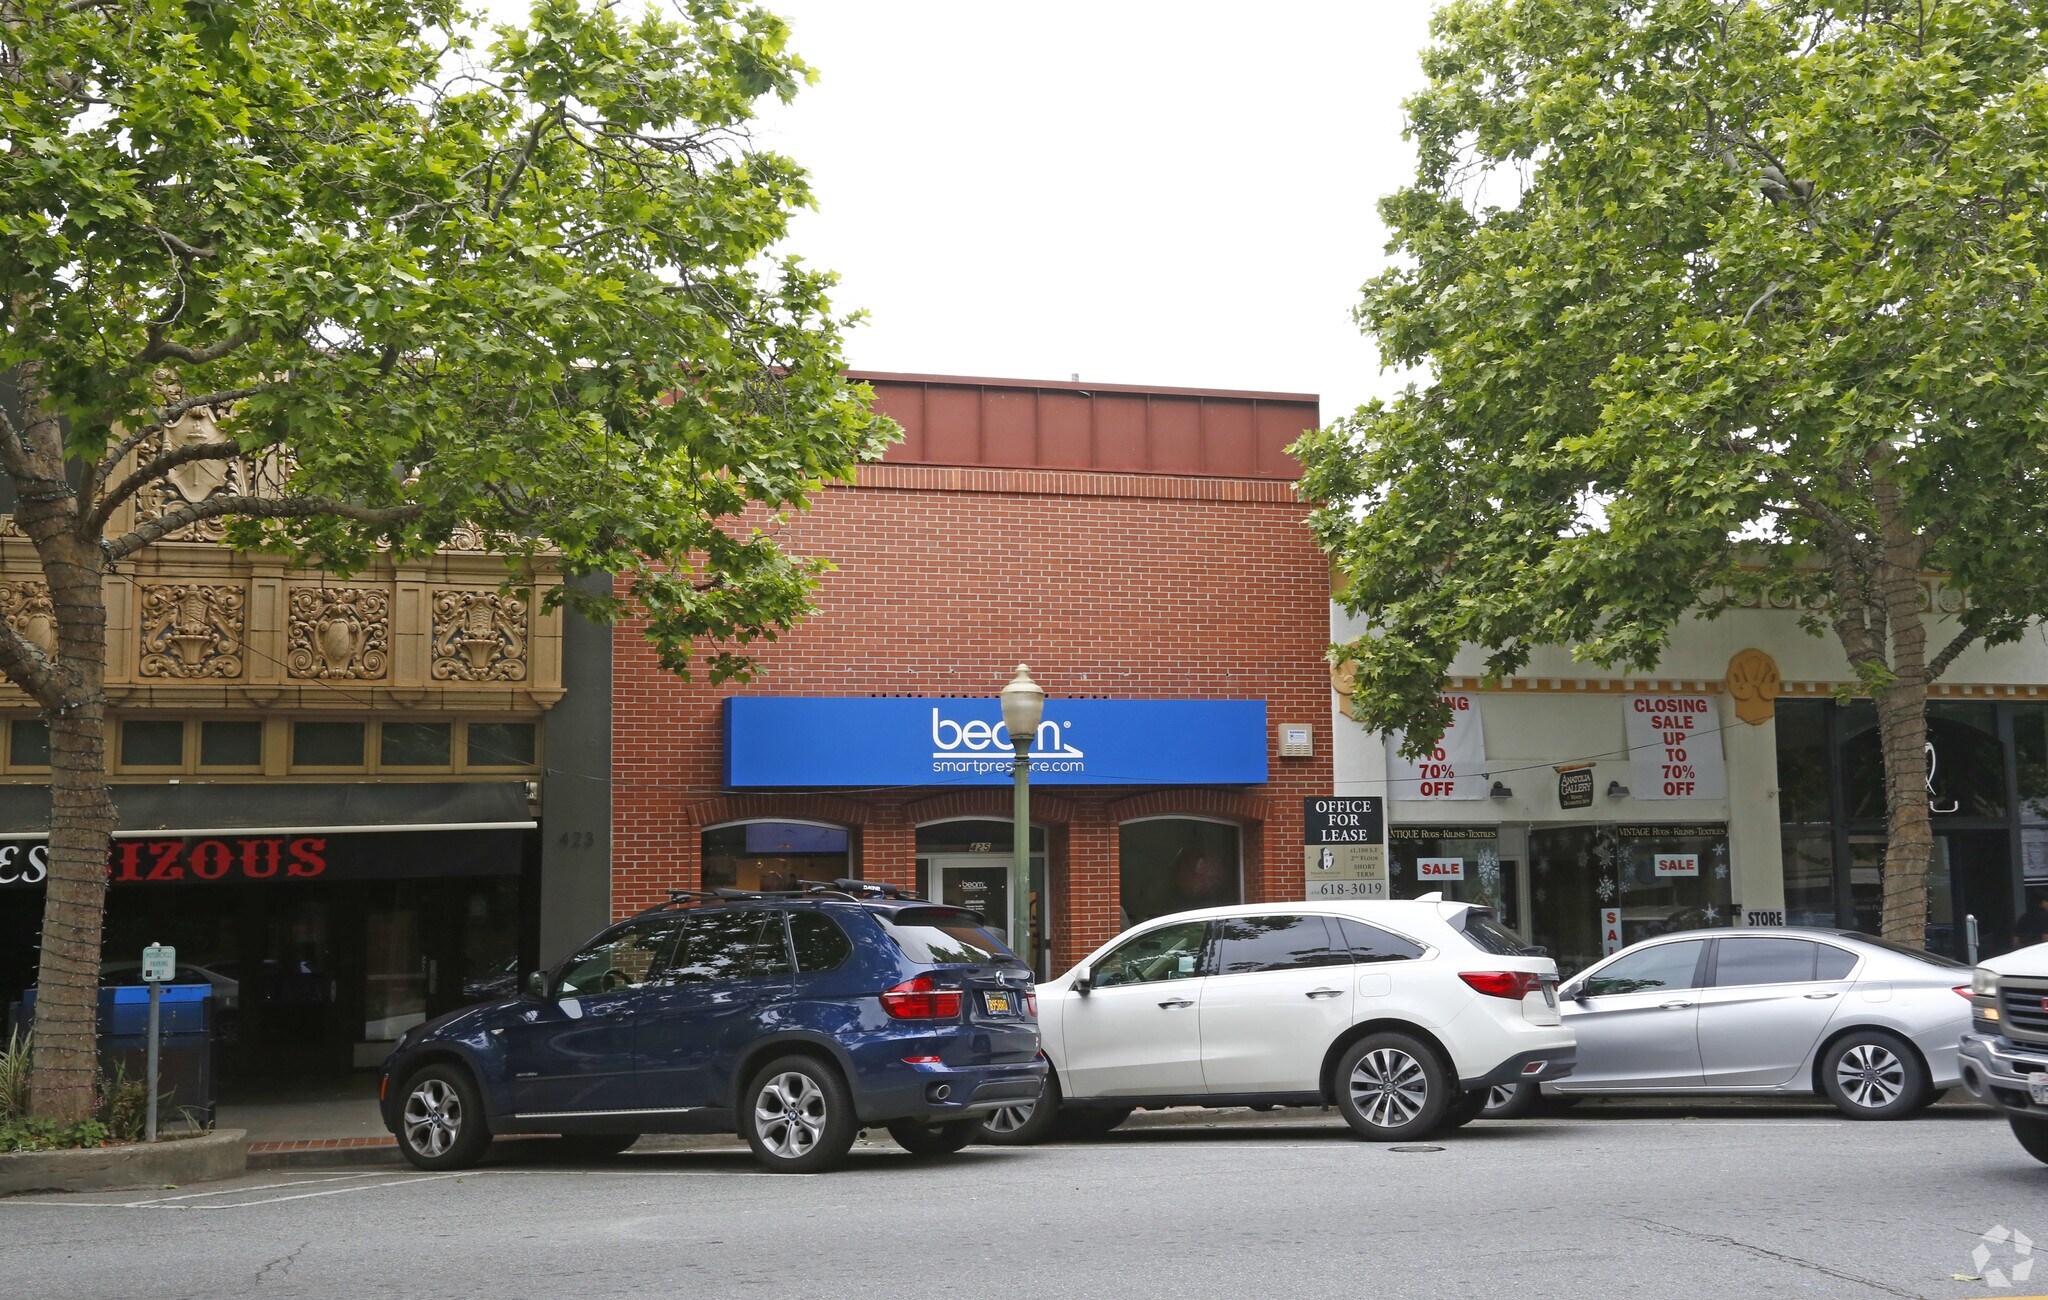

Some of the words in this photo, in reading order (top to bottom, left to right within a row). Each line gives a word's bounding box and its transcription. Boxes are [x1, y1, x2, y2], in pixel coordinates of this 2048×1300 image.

[1634, 699, 1708, 713] CLOSING
[1651, 716, 1694, 729] SALE
[1663, 732, 1686, 745] UP
[1665, 749, 1687, 762] TO
[932, 760, 1084, 775] smartpresce.com
[1419, 764, 1455, 779] 70%
[1661, 765, 1695, 779] 70%
[1561, 774, 1591, 786] ANATOLIA
[1420, 782, 1454, 797] OFF
[1561, 783, 1591, 796] GALLERY
[1663, 782, 1695, 796] OFF
[1315, 800, 1372, 813] OFFICE
[1328, 814, 1360, 826] FOR
[1321, 829, 1368, 842] LEASE
[1467, 829, 1496, 838] TEXTILES
[1619, 827, 1651, 837] VINTAGE
[969, 843, 991, 852] 425
[106, 838, 327, 882] IZOUS
[1659, 859, 1695, 870] SALE
[1422, 863, 1460, 875] SALE
[1320, 882, 1382, 896] 618-3019
[1747, 911, 1783, 927] STORE
